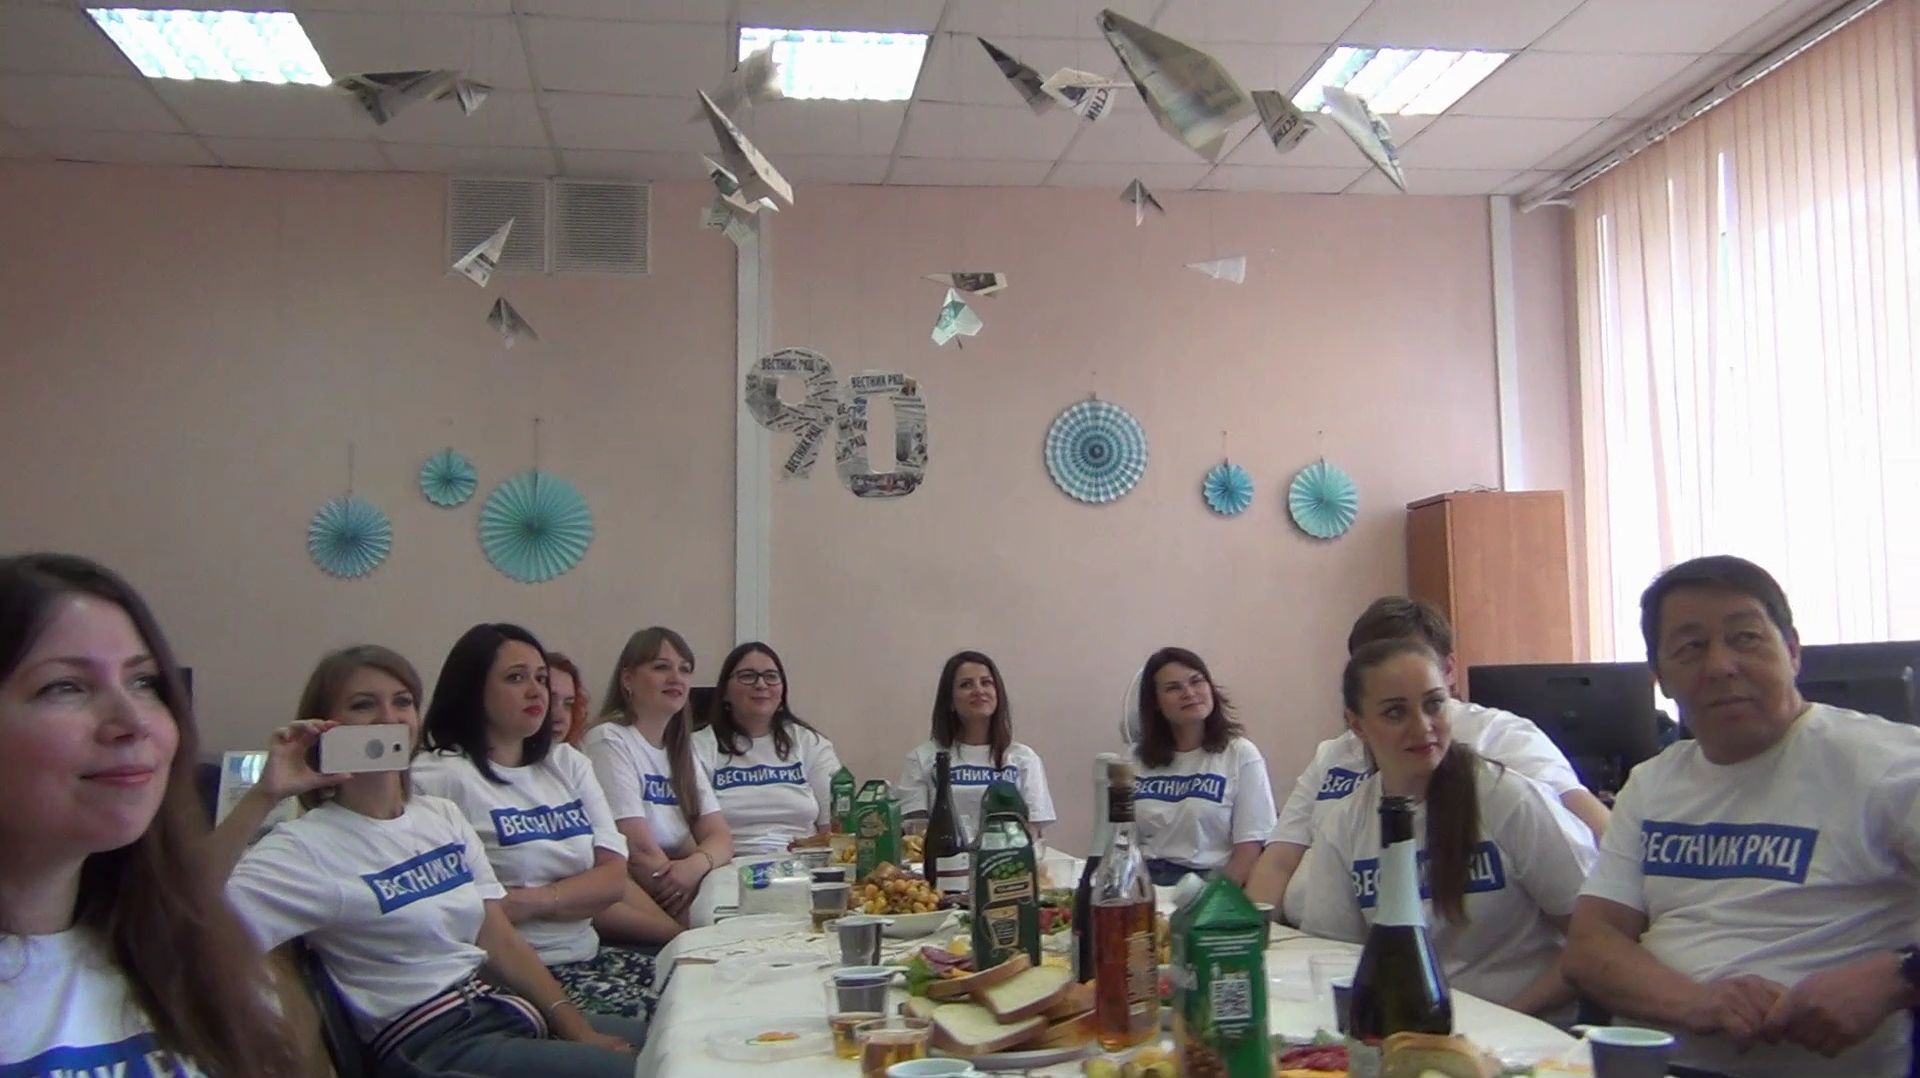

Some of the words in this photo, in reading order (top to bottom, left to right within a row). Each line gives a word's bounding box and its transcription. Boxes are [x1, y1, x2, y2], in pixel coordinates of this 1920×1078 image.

[850, 375, 886, 388] ВЕСТНИК
[785, 439, 812, 473] ВЕСТНИК
[717, 768, 778, 786] ВЕСТНИК
[1191, 777, 1220, 798] РКЦ
[1639, 831, 1744, 867] ВЕСТНИК
[1741, 834, 1803, 876] РКЦ
